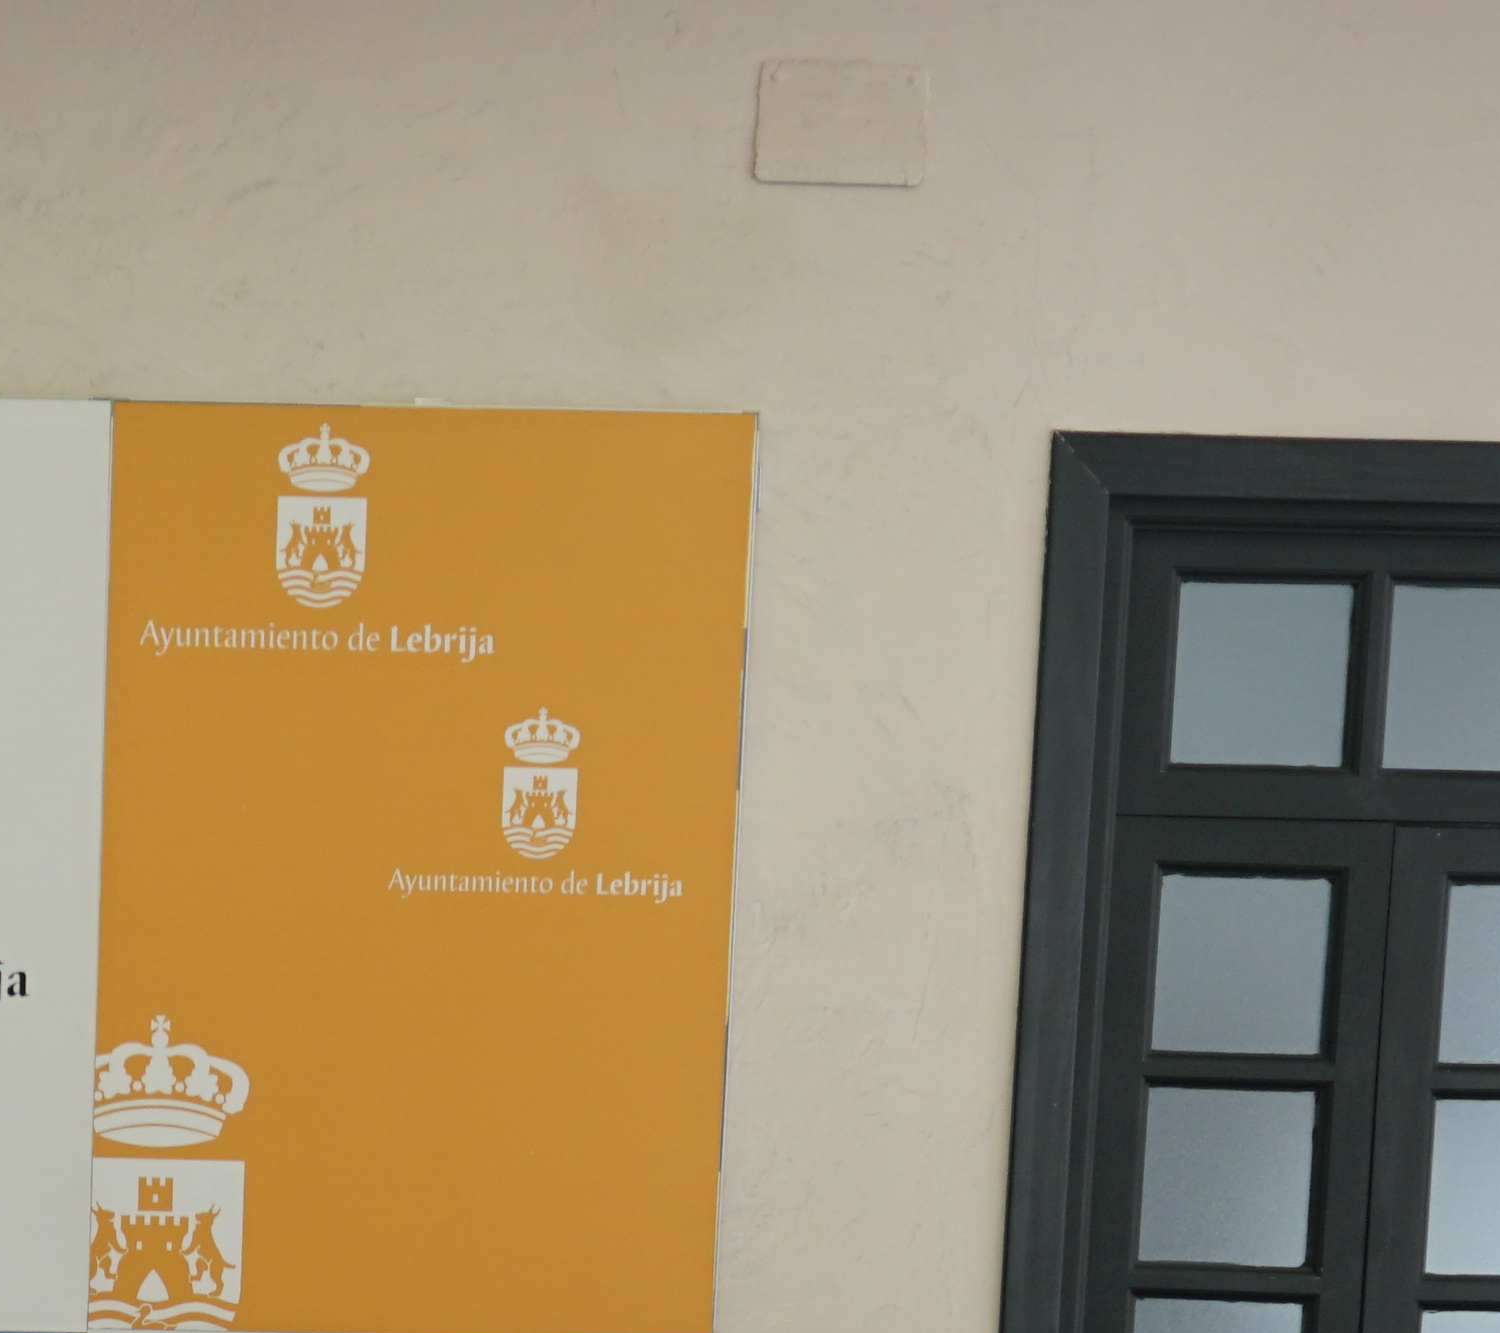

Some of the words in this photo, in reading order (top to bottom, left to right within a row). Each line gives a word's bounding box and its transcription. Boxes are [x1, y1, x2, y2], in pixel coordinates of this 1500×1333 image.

[139, 619, 339, 656] Ayuntamiento
[347, 622, 381, 652] de
[390, 624, 495, 664] Lebrija
[388, 868, 554, 898] Ayuntamiento
[560, 870, 588, 895] de
[596, 872, 683, 904] Lebrija
